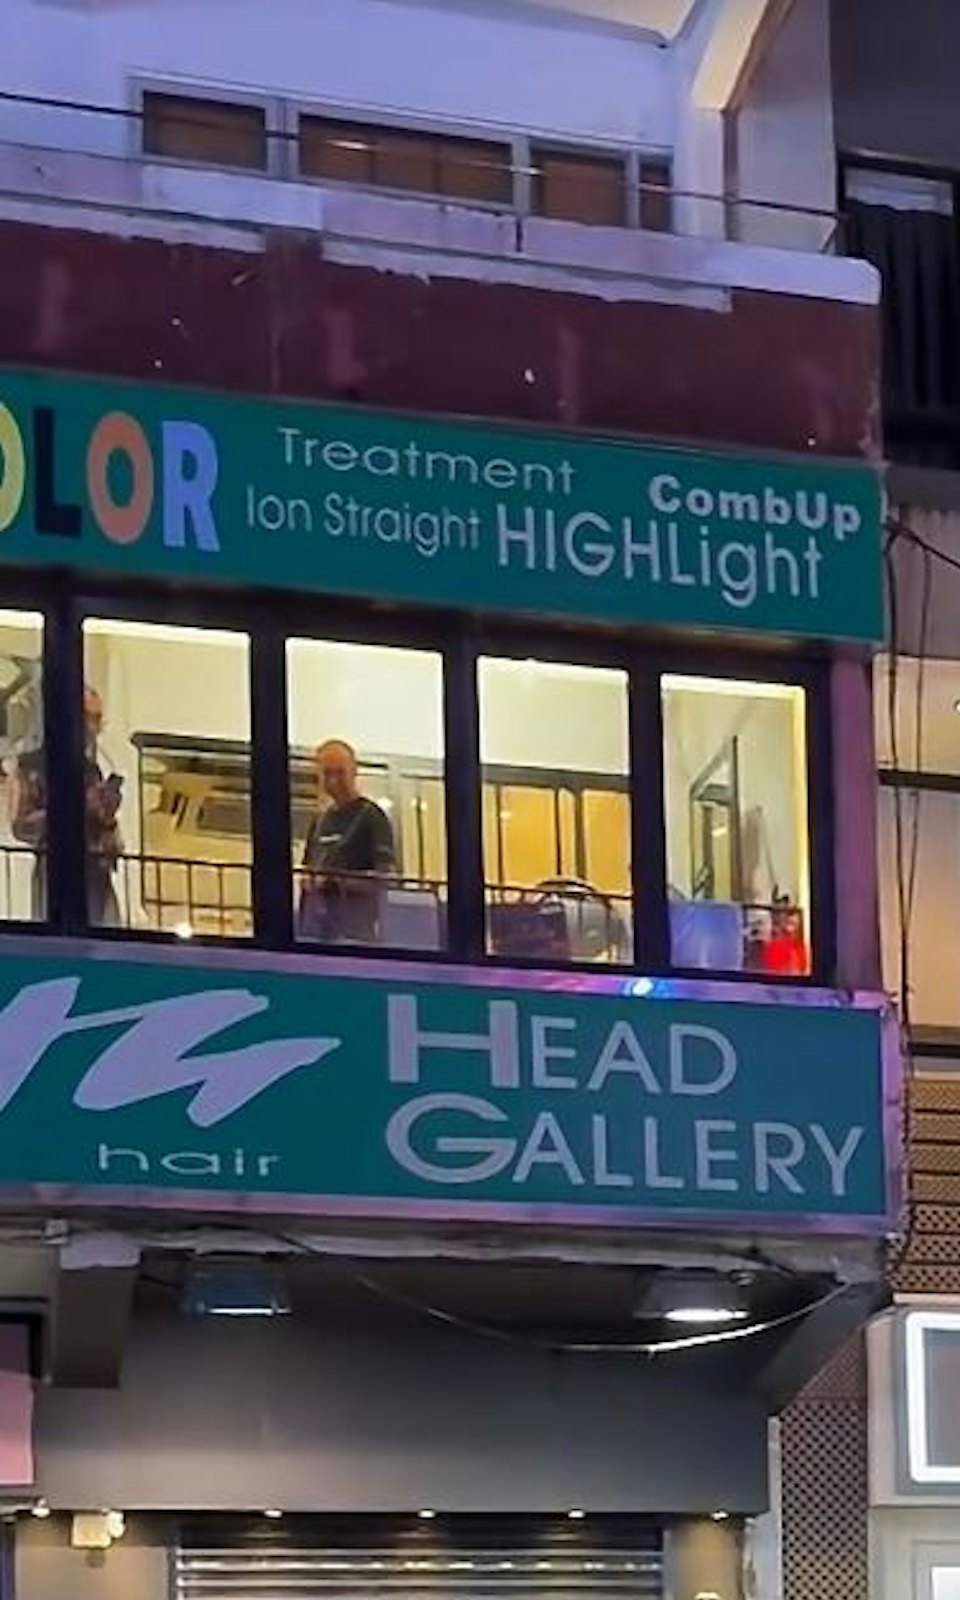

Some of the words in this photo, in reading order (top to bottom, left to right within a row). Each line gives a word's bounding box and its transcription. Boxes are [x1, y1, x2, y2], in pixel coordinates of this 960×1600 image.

[277, 427, 576, 494] Treatment
[246, 484, 313, 532] Ion
[323, 492, 481, 556] Straight
[650, 473, 862, 541] CombUp
[496, 503, 824, 607] HIGHLight
[387, 994, 737, 1096] HEAD
[99, 1143, 279, 1176] hair
[385, 1092, 864, 1196] GALLERY
